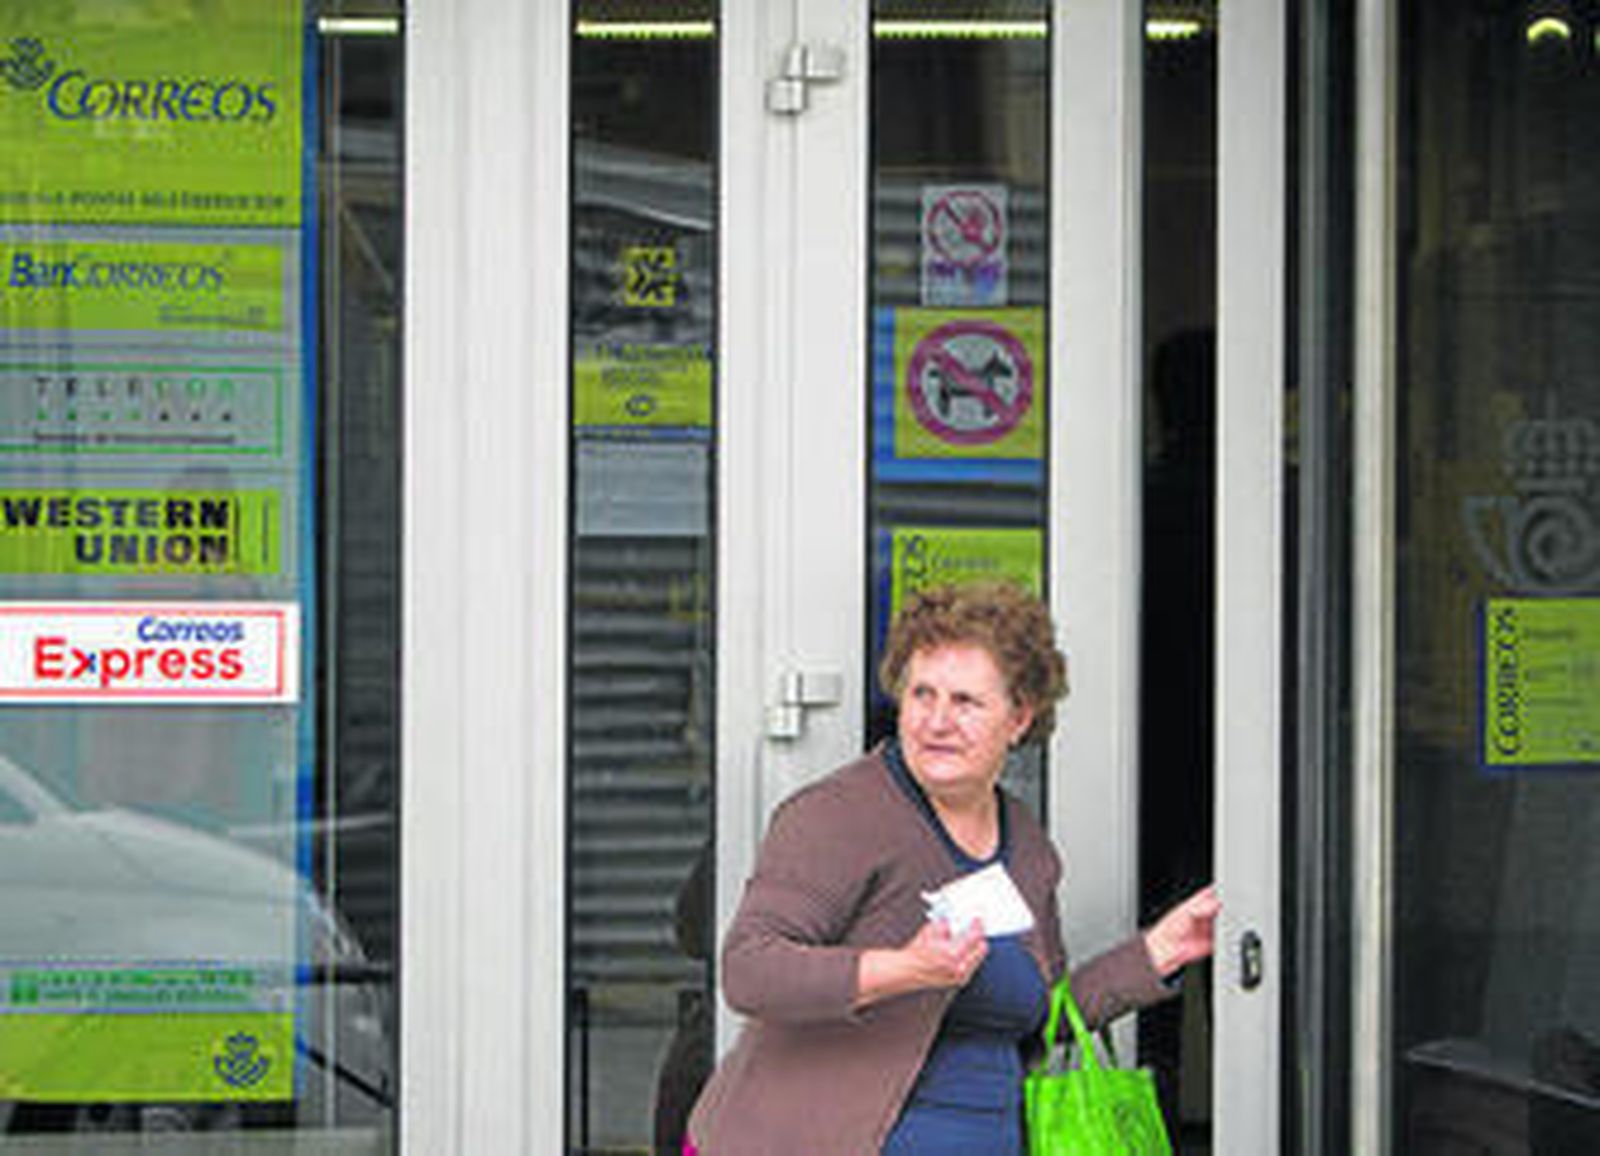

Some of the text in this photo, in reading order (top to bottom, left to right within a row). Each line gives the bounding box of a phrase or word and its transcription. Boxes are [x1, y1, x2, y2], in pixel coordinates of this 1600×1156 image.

[47, 70, 276, 121] CORREOS
[3, 497, 229, 528] WESTERN
[75, 534, 229, 565] UNION
[137, 616, 245, 643] Correos
[34, 636, 244, 688] Express
